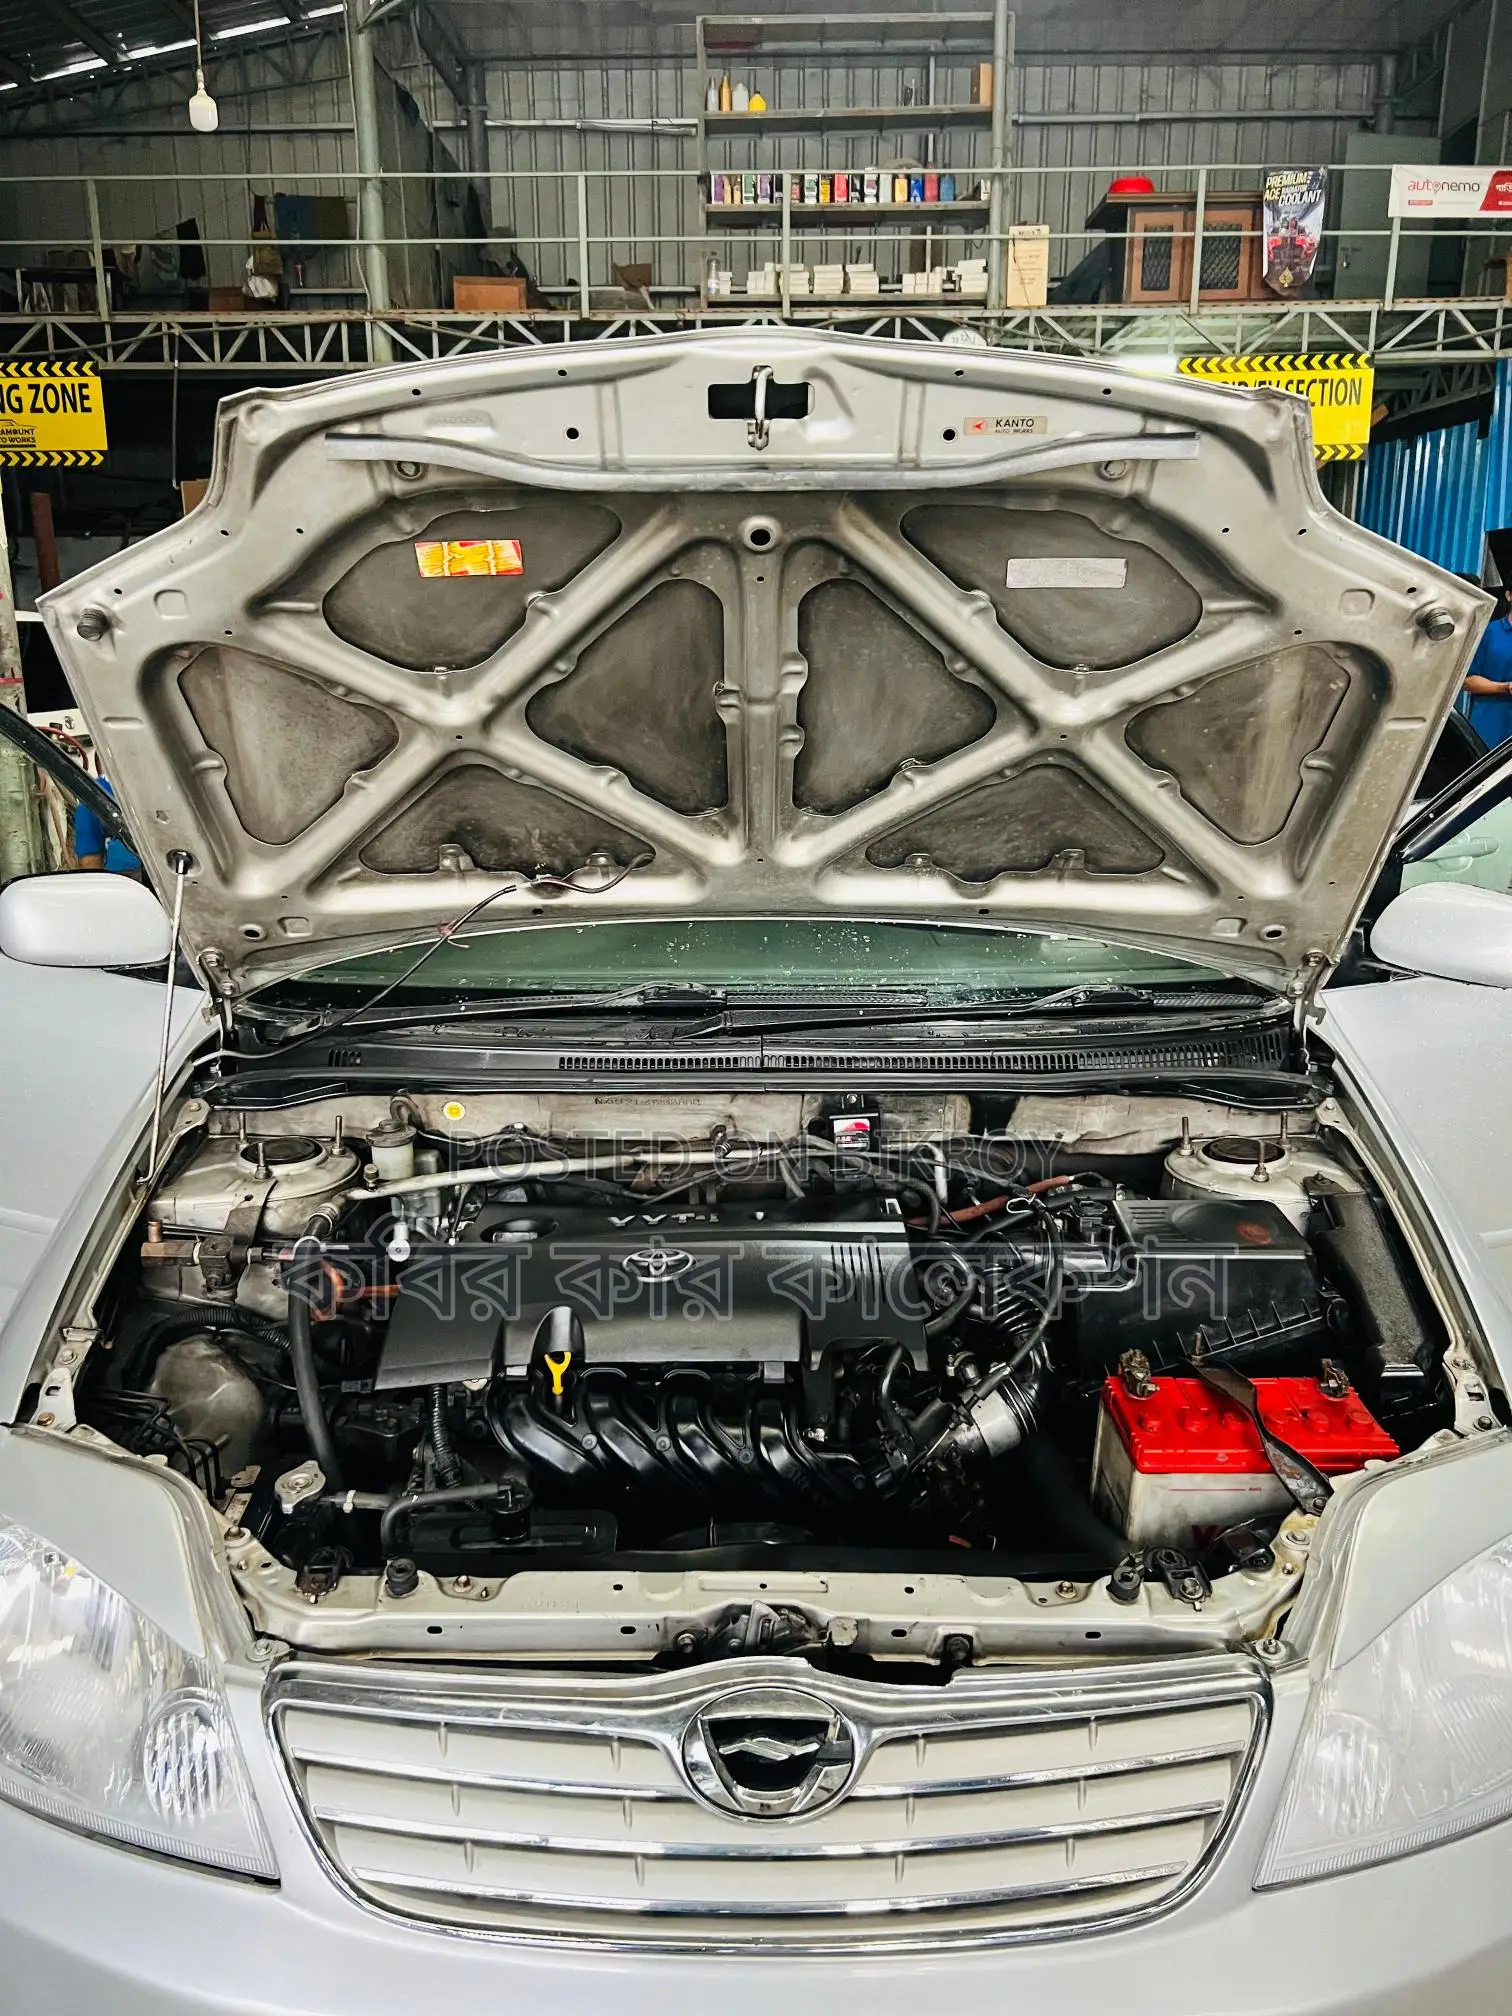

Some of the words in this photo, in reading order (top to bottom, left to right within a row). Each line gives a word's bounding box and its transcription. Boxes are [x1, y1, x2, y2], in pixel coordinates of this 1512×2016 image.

[1265, 172, 1308, 189] PREMIUM
[1408, 179, 1480, 195] autonemo
[1264, 187, 1281, 201] ACE
[1279, 189, 1322, 207] COOLANT
[28, 383, 92, 413] ZONE
[996, 418, 1034, 427] KANTO
